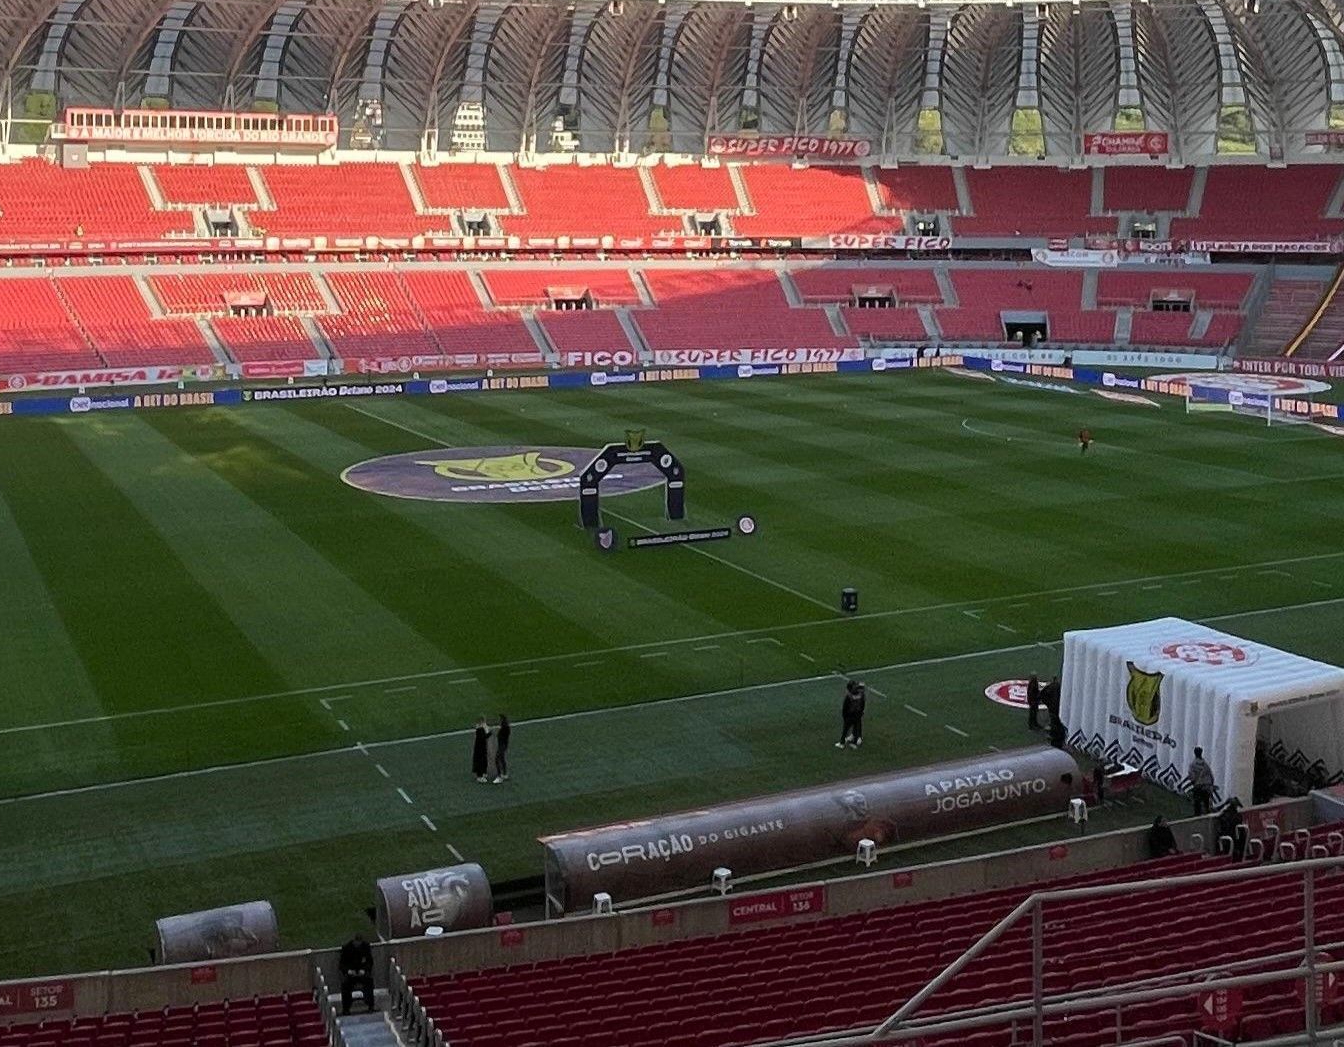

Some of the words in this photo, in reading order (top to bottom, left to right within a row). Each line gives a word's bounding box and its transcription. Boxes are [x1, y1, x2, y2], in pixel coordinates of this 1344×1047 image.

[727, 139, 779, 154] SUPER
[782, 136, 819, 152] FICO
[822, 139, 854, 155] 1977
[832, 236, 896, 249] SUPER
[567, 351, 633, 366] FICO
[1242, 360, 1272, 373] INTER
[1274, 361, 1296, 373] POR
[1299, 364, 1327, 377] TODA
[254, 386, 338, 400] BRASILEIRÃO
[375, 384, 403, 394] 2024
[925, 783, 940, 796] A
[932, 791, 984, 814] JOGA
[587, 833, 694, 872] CORAÇÃO
[698, 833, 719, 846] DO
[723, 819, 785, 840] GIGANTE
[733, 902, 778, 917] CENTRAL
[30, 984, 65, 997] SETOR
[34, 994, 58, 1009] 135
